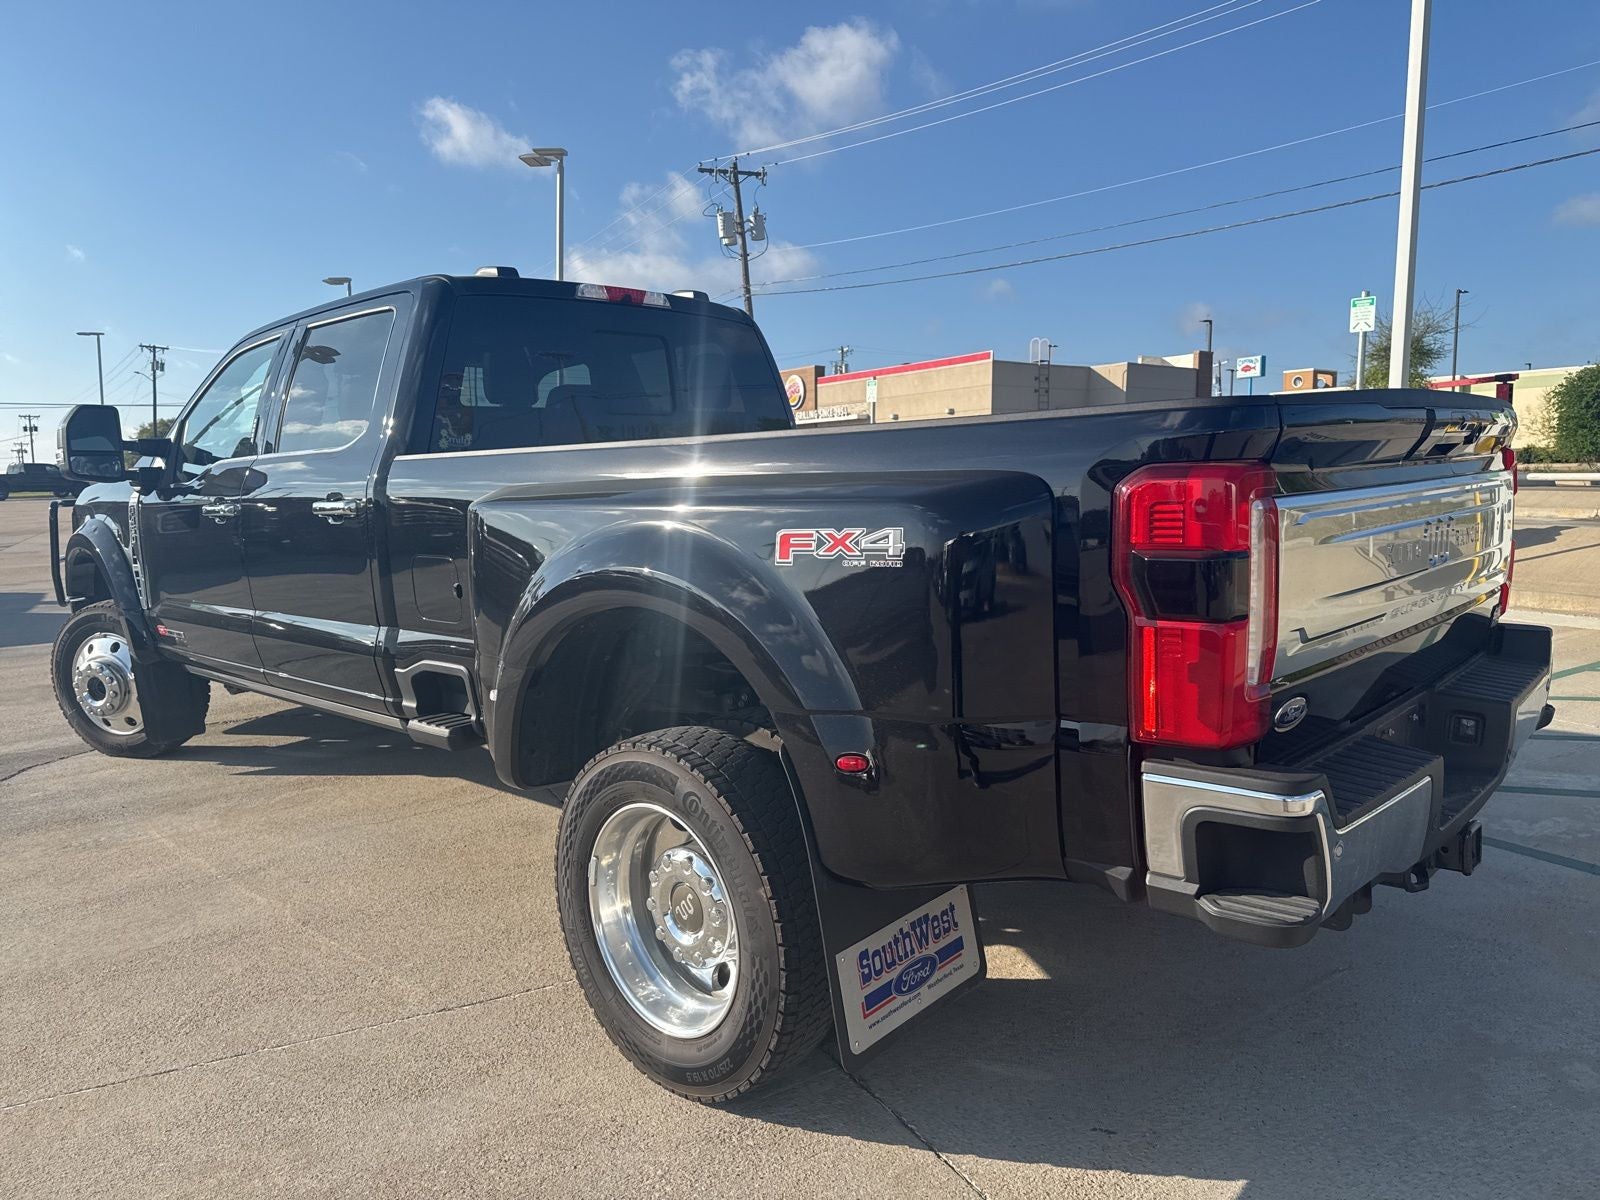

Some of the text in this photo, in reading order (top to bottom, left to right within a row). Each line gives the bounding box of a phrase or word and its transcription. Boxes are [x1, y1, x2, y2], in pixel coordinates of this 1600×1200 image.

[775, 527, 905, 566] FX4
[842, 559, 903, 568] OFF ROAD
[1391, 594, 1435, 618] SUPER
[858, 902, 958, 988] SouthWest
[902, 961, 932, 991] Ford
[868, 991, 922, 1030] www.southwestford.com
